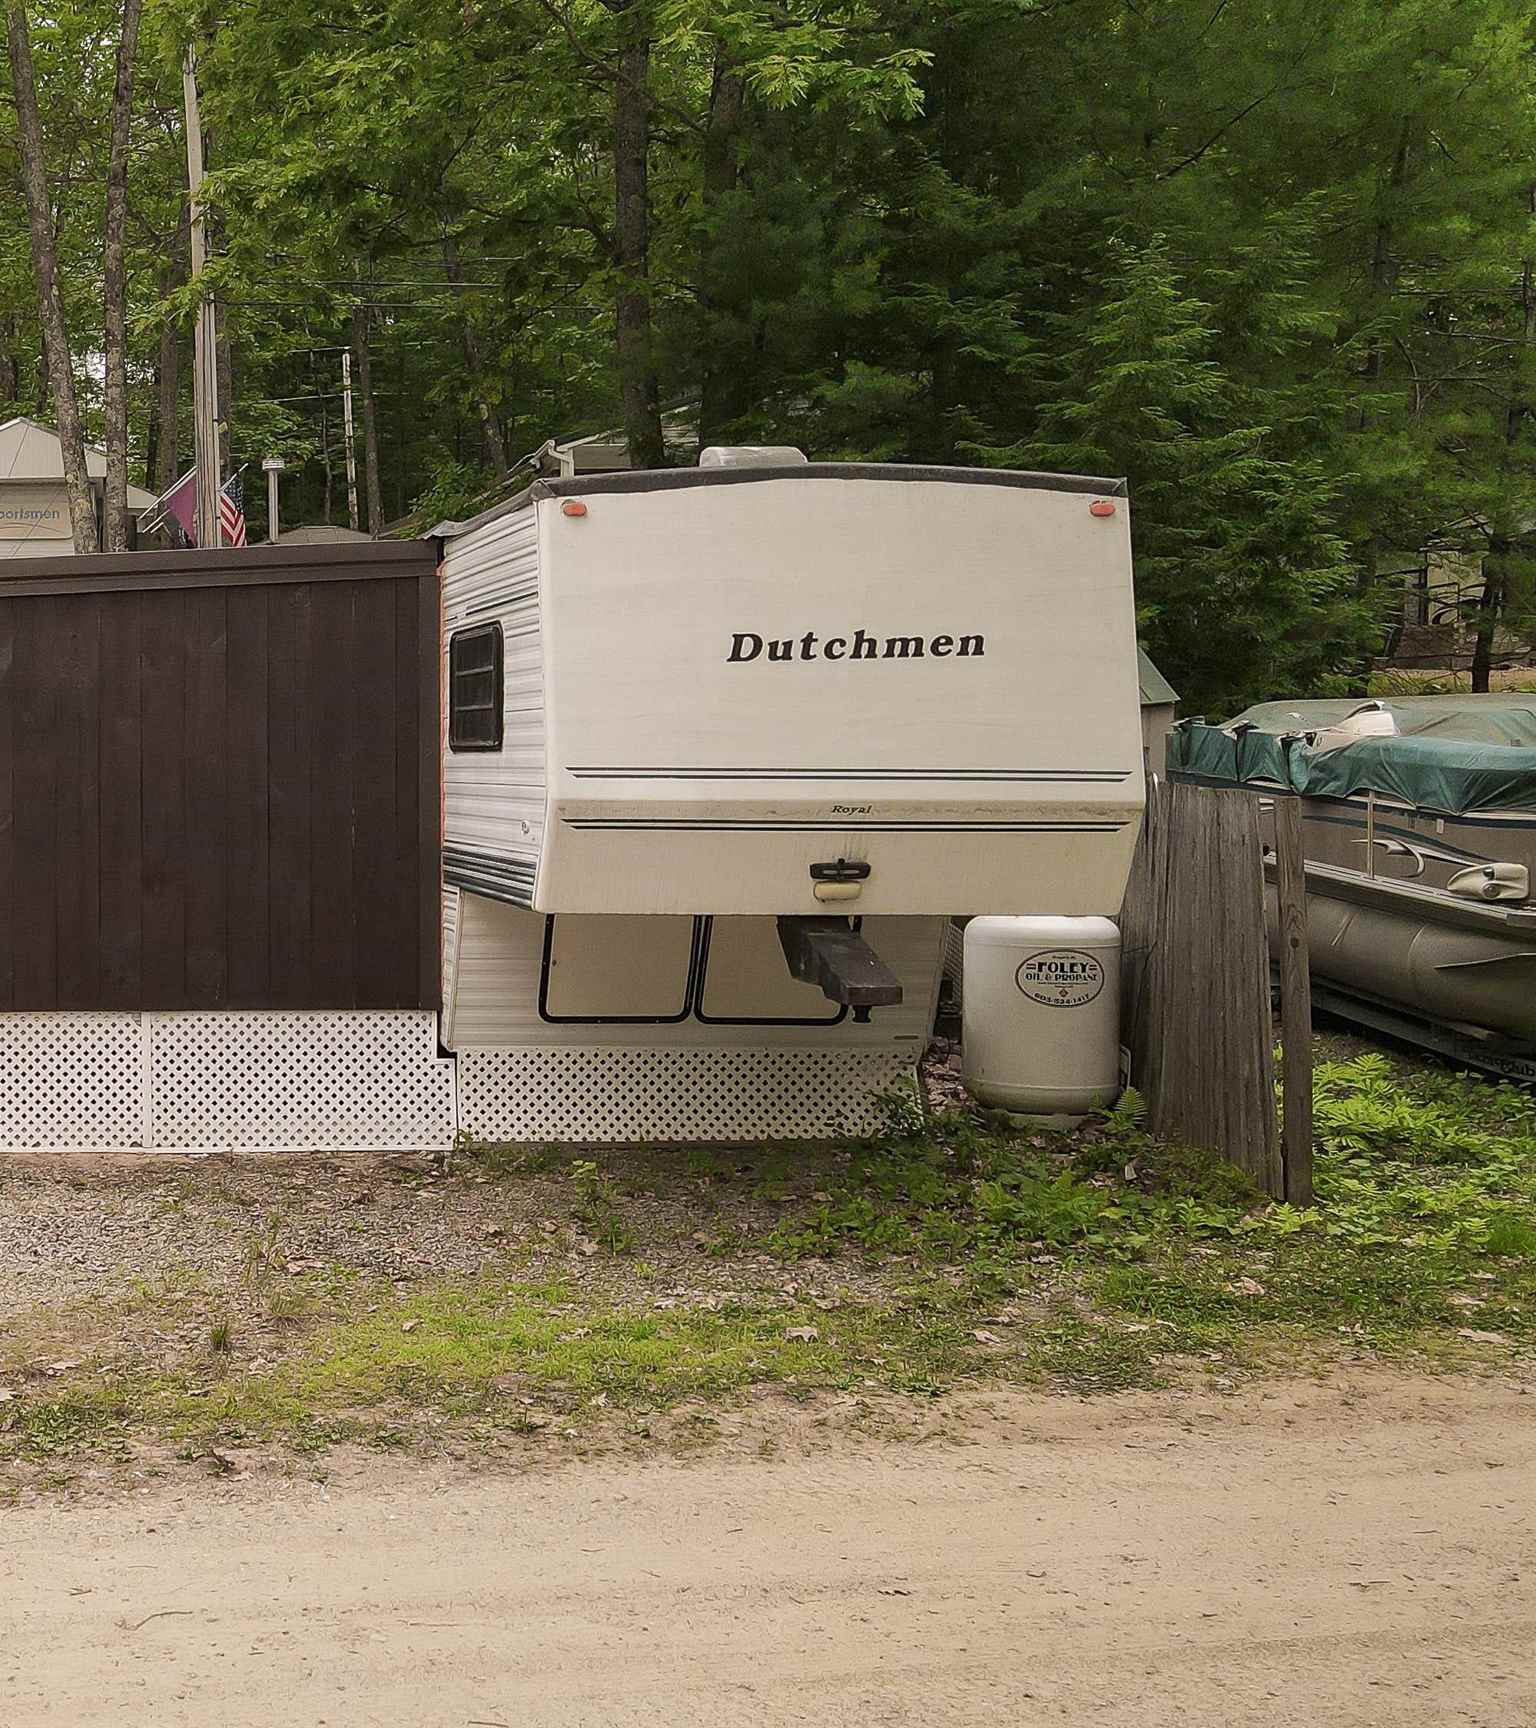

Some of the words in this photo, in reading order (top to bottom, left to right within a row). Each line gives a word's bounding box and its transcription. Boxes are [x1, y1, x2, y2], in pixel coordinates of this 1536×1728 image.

[726, 629, 985, 663] Dutchmen
[831, 805, 872, 816] Royal
[1037, 962, 1089, 974] FOLEY
[1025, 973, 1041, 981] OIL
